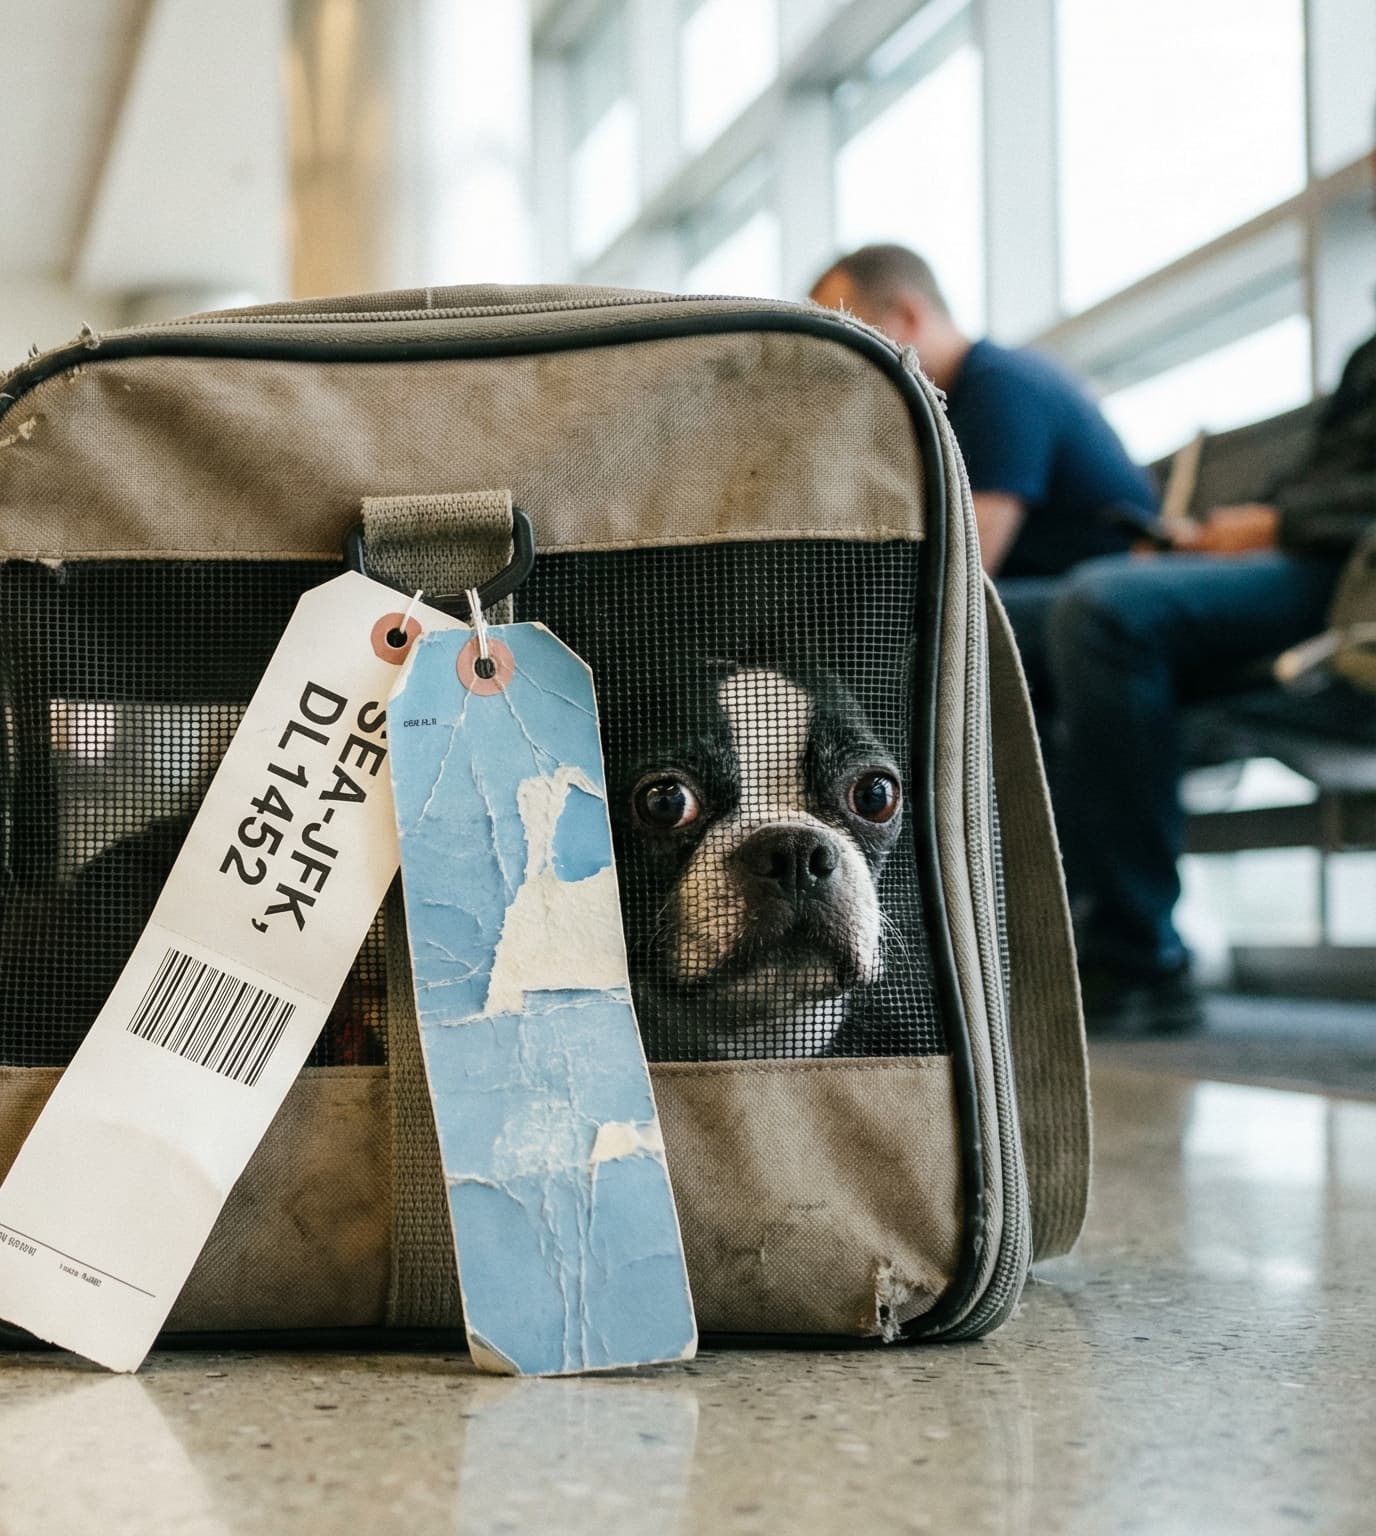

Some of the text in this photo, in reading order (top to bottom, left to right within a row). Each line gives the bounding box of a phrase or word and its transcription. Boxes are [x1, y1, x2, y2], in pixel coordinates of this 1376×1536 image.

[219, 681, 348, 886] DL 1452
[251, 701, 387, 933] SEA-JFK,
